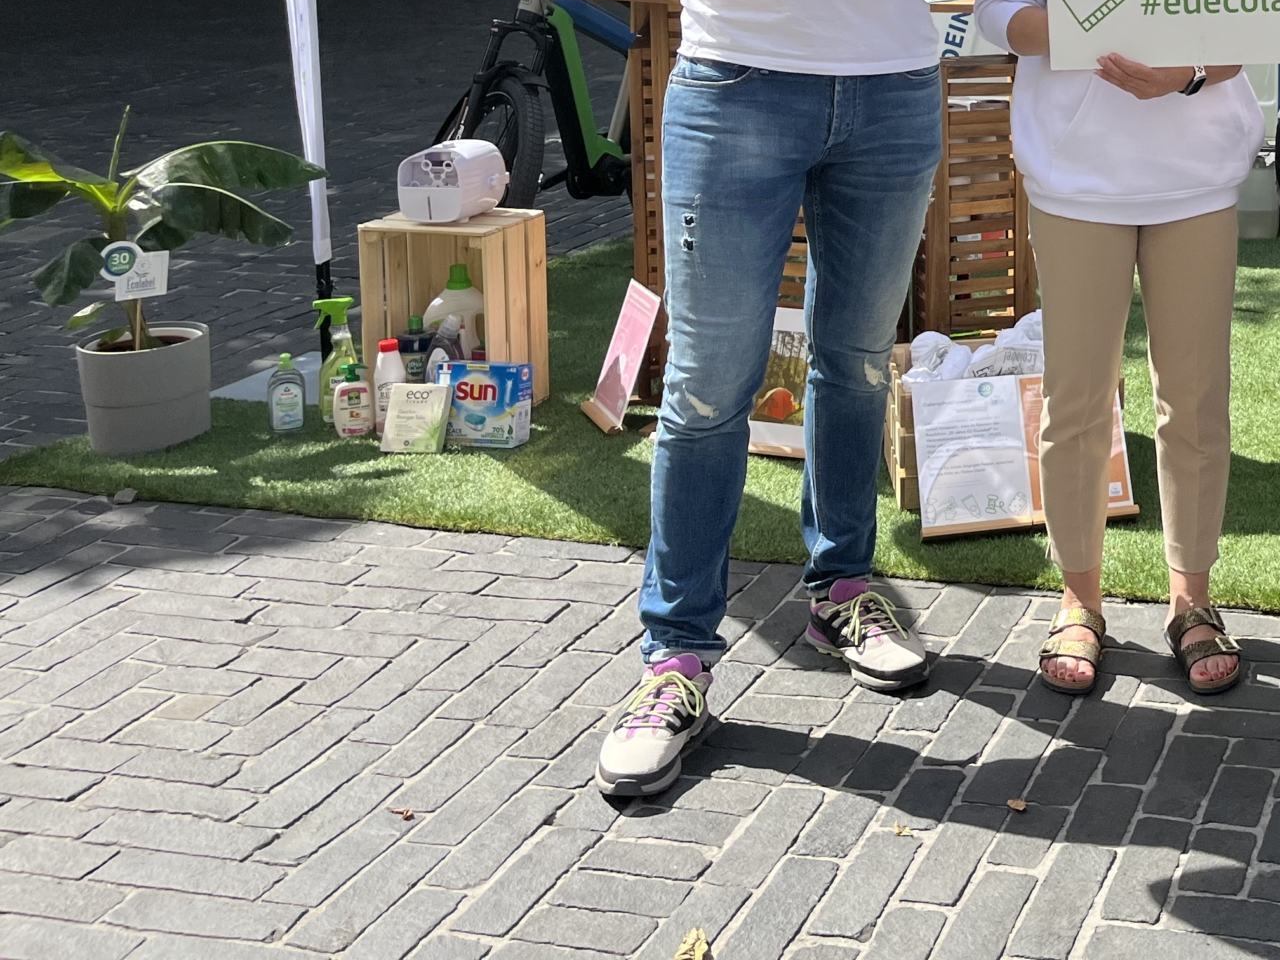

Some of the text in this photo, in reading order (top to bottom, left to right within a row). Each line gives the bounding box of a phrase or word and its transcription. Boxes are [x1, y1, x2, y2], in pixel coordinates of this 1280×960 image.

[111, 252, 130, 265] 30
[126, 277, 156, 290] Ecolabel
[406, 390, 430, 400] eco
[455, 381, 498, 402] Sun
